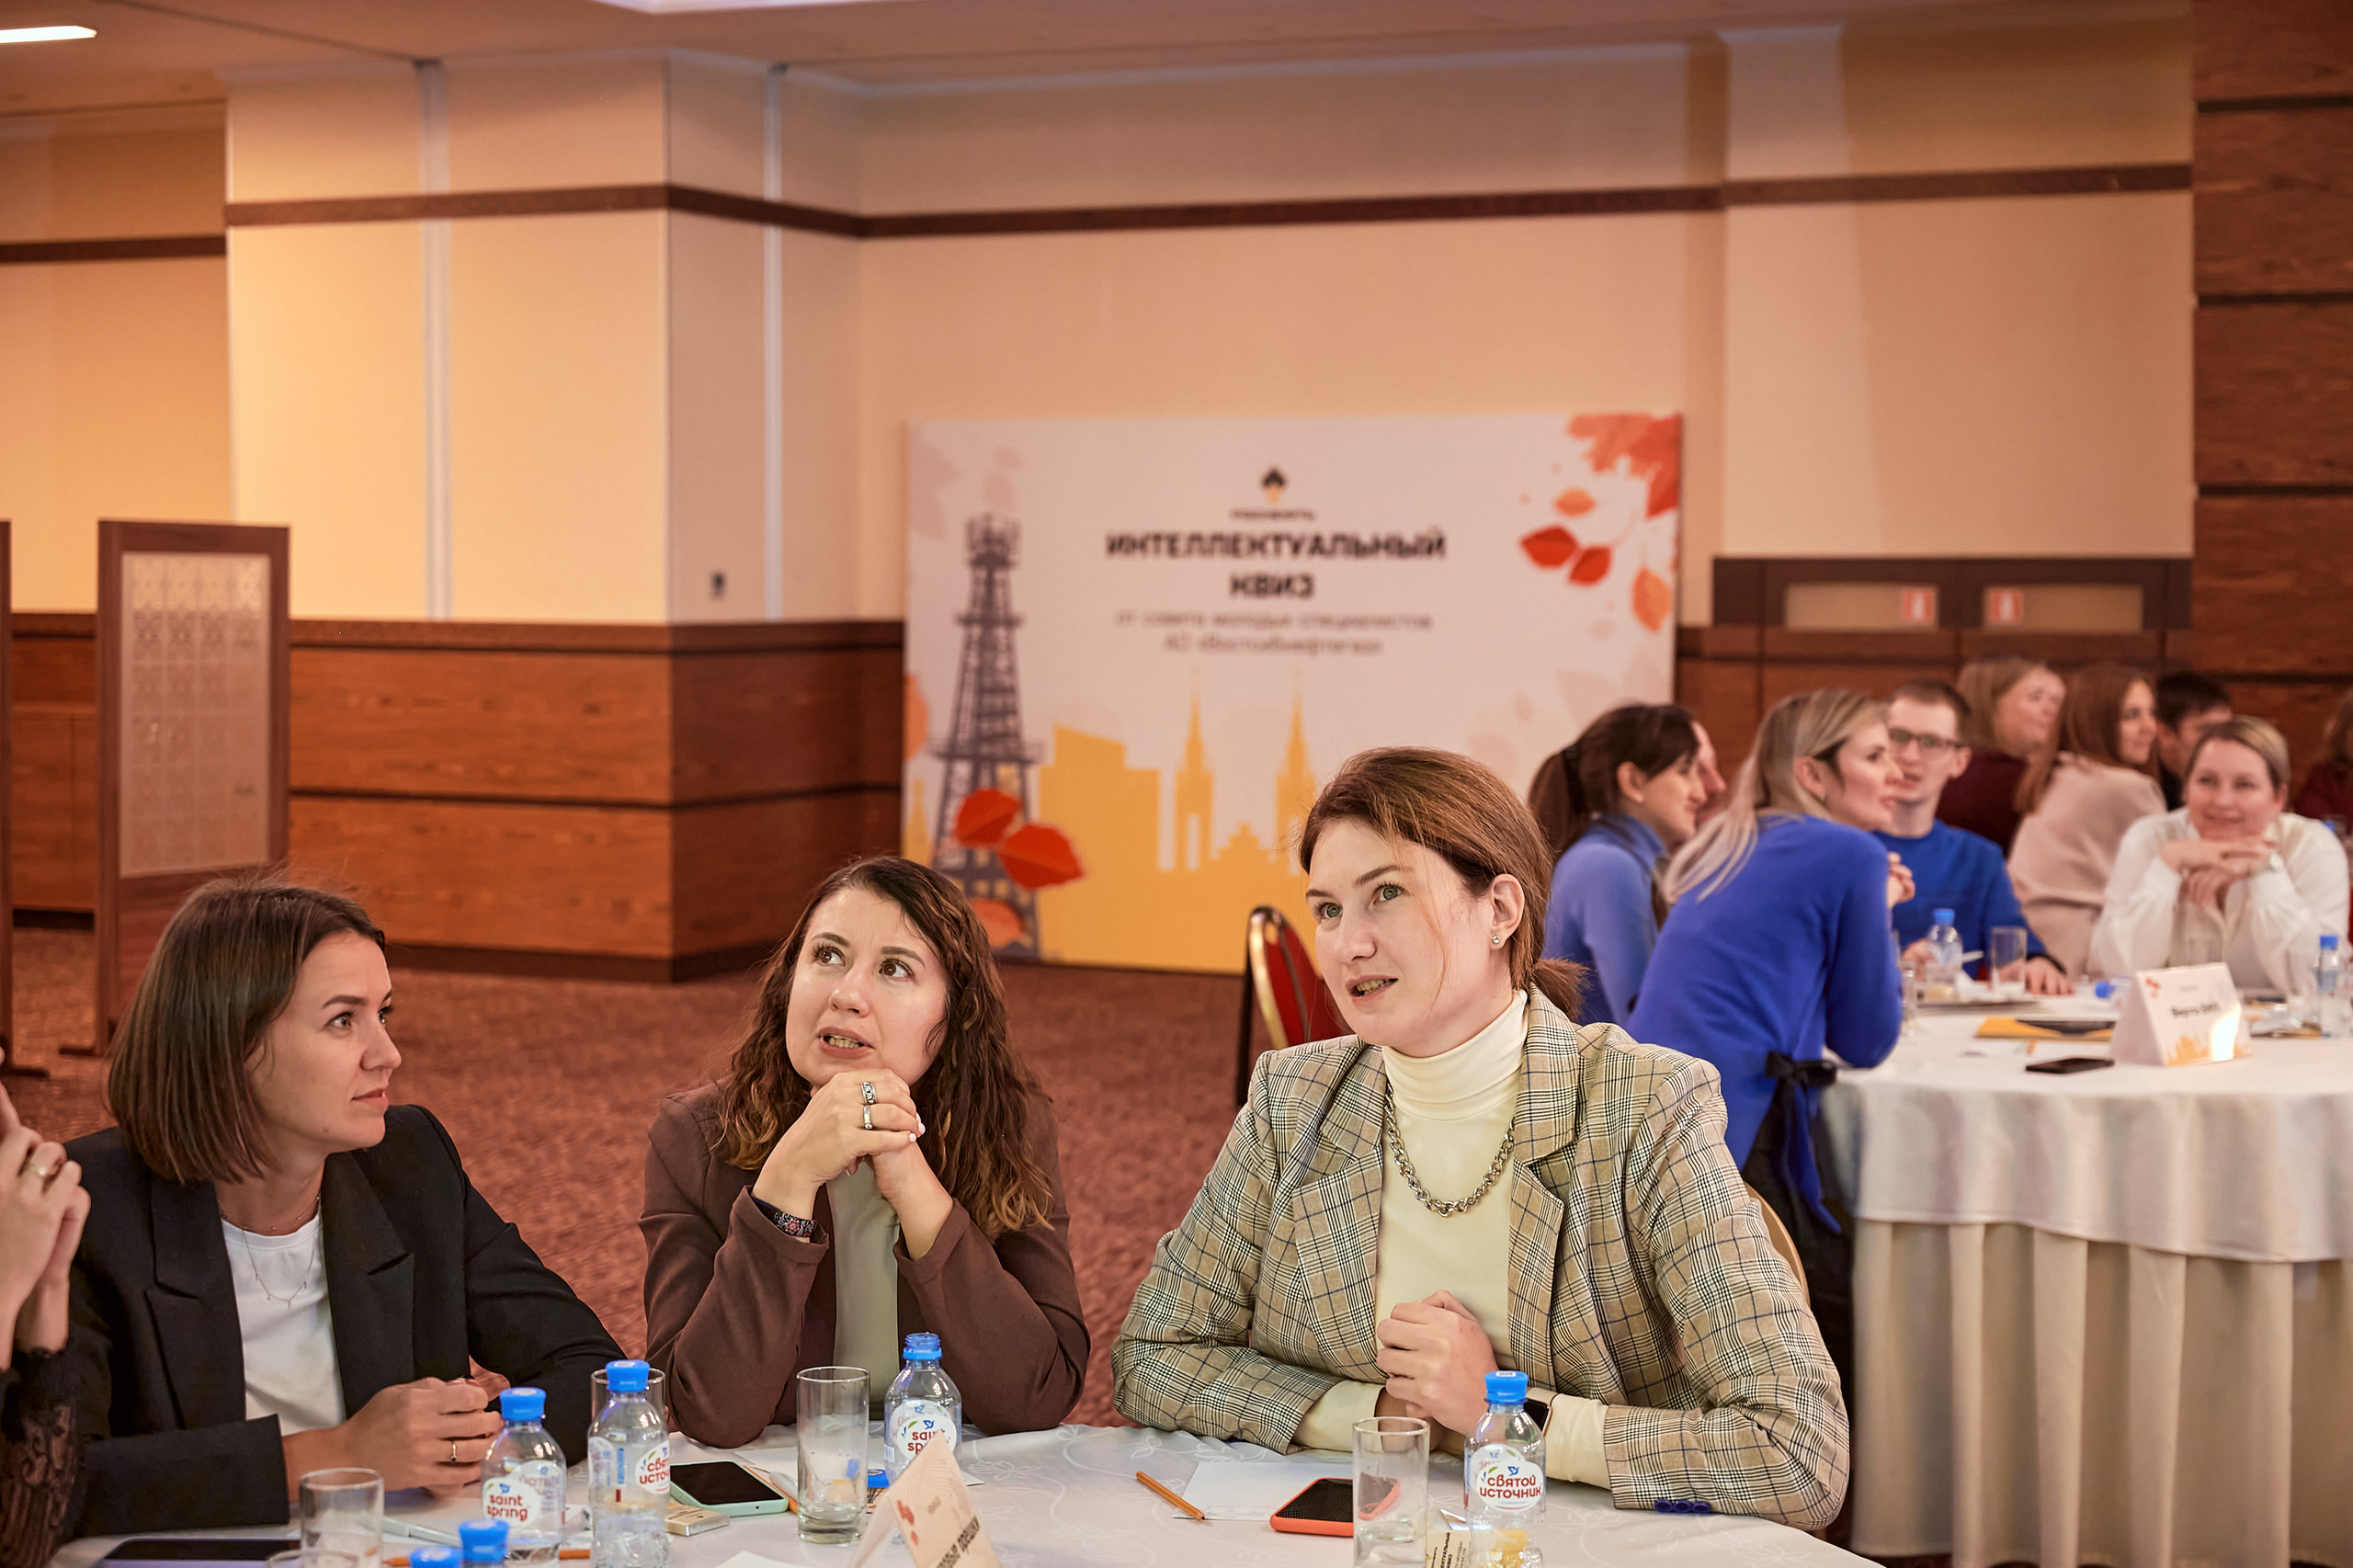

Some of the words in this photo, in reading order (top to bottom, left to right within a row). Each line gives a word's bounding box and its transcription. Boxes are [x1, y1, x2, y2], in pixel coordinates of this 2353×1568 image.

[1106, 526, 1447, 558] ИНТЕЛЛЕКТУАЛЬНЫЙ
[1229, 572, 1315, 597] КВИЗ
[1487, 1474, 1536, 1487] святой
[1479, 1486, 1541, 1498] источник
[489, 1494, 523, 1506] saint
[486, 1506, 529, 1522] spring
